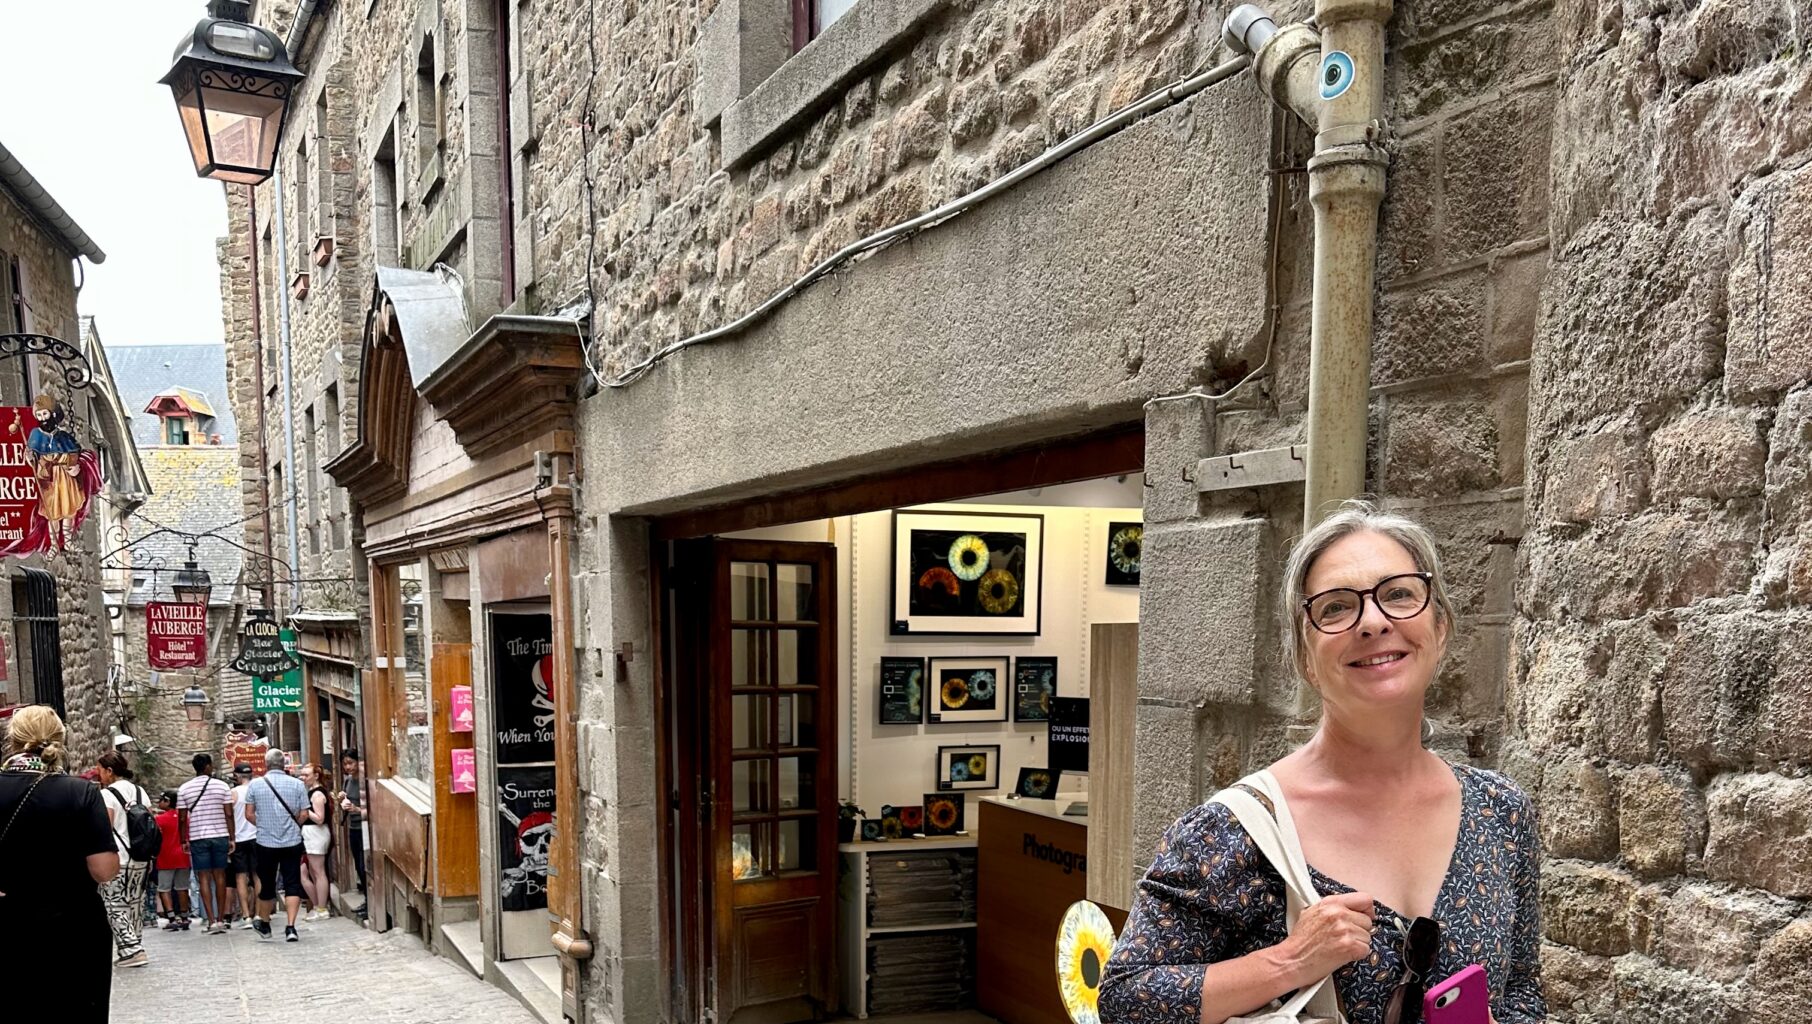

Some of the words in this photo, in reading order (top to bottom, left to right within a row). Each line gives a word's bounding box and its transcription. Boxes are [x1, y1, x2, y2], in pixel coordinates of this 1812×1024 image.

[150, 607, 162, 619] LA
[161, 605, 204, 620] VIEILLE
[149, 620, 204, 636] AUBERGE
[245, 624, 255, 636] LA
[255, 622, 279, 636] CLOCHE
[167, 641, 187, 651] Hôtel
[506, 637, 530, 656] The
[159, 650, 196, 660] Restaurant
[243, 649, 284, 661] Glacier
[236, 660, 293, 675] Crêperie
[258, 685, 302, 696] Glacier
[256, 698, 282, 708] BAR
[497, 728, 532, 744] When
[1051, 733, 1089, 743] EXPLOSIO
[504, 783, 557, 800] Surren
[533, 799, 551, 809] the
[1023, 832, 1087, 875] Photogra
